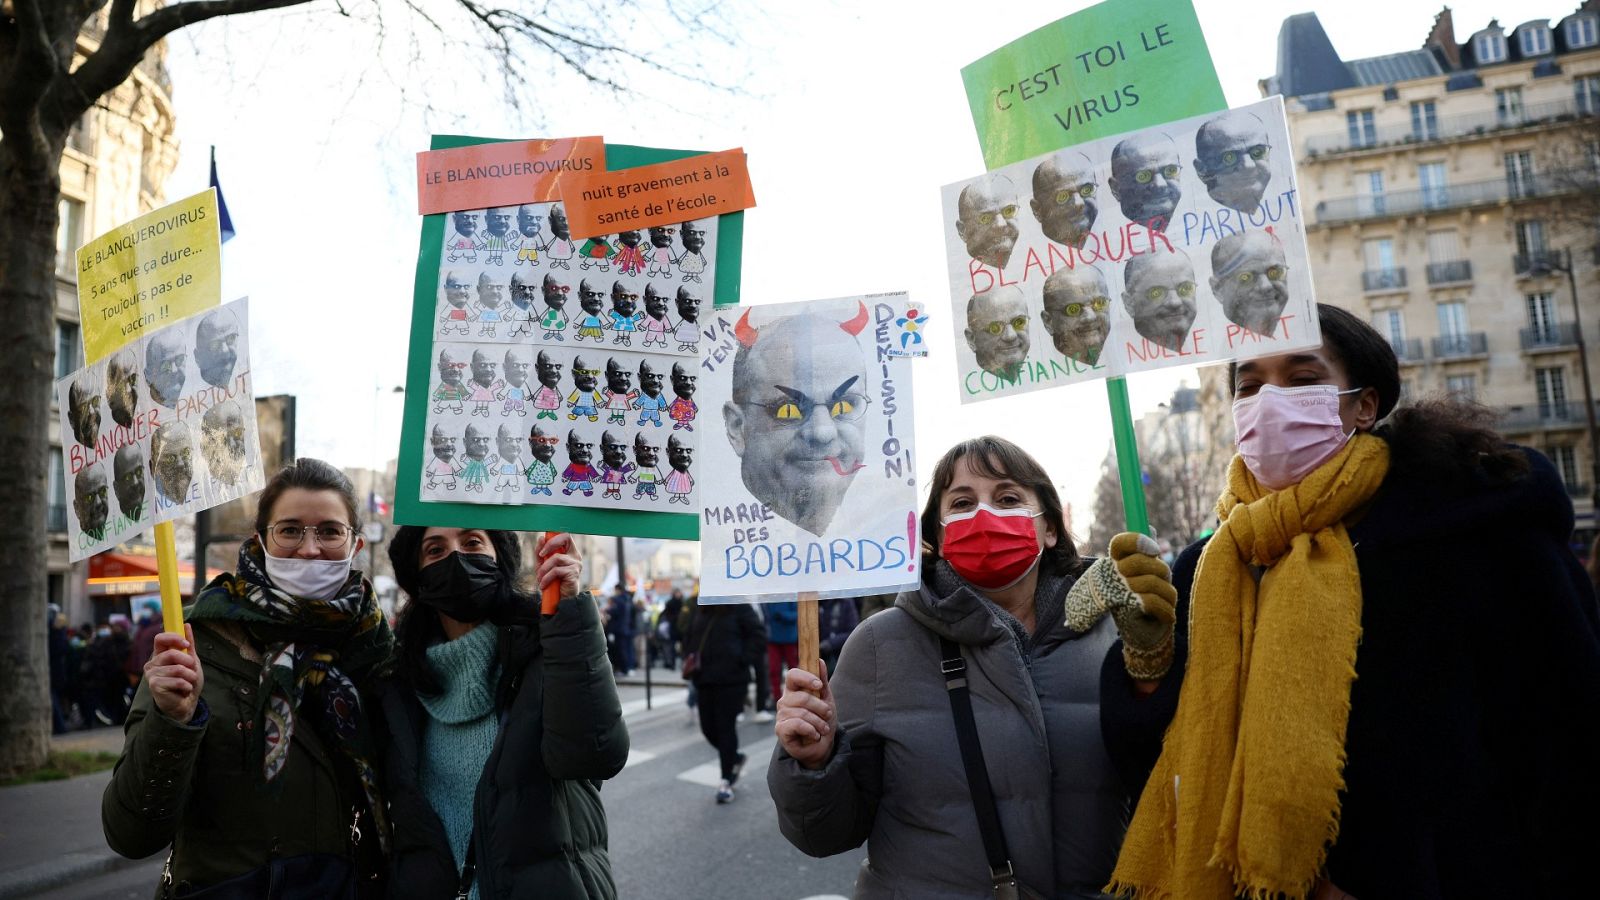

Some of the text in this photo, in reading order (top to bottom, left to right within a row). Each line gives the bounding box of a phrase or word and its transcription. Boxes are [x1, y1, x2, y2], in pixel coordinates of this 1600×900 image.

[995, 23, 1174, 111] C'EST TOI LE
[1053, 84, 1140, 131] VIRUS
[426, 156, 593, 185] LE BLANQUEROVIRUS
[582, 165, 729, 201] nuit gravement à la
[597, 206, 640, 225] santé
[644, 203, 664, 217] de
[667, 193, 717, 213] l'école
[82, 206, 206, 272] LE BLANQUEROVIRUS
[969, 189, 1296, 295] BLANQUER PARTOUT
[91, 245, 203, 299] 5 ans que ça dure...
[101, 273, 193, 321] Toujours pas de
[121, 313, 155, 336] vaccin
[703, 316, 731, 342] VA
[70, 370, 250, 475] BLANQUER PARTOUT
[705, 501, 774, 526] MARRE
[733, 526, 770, 544] DES
